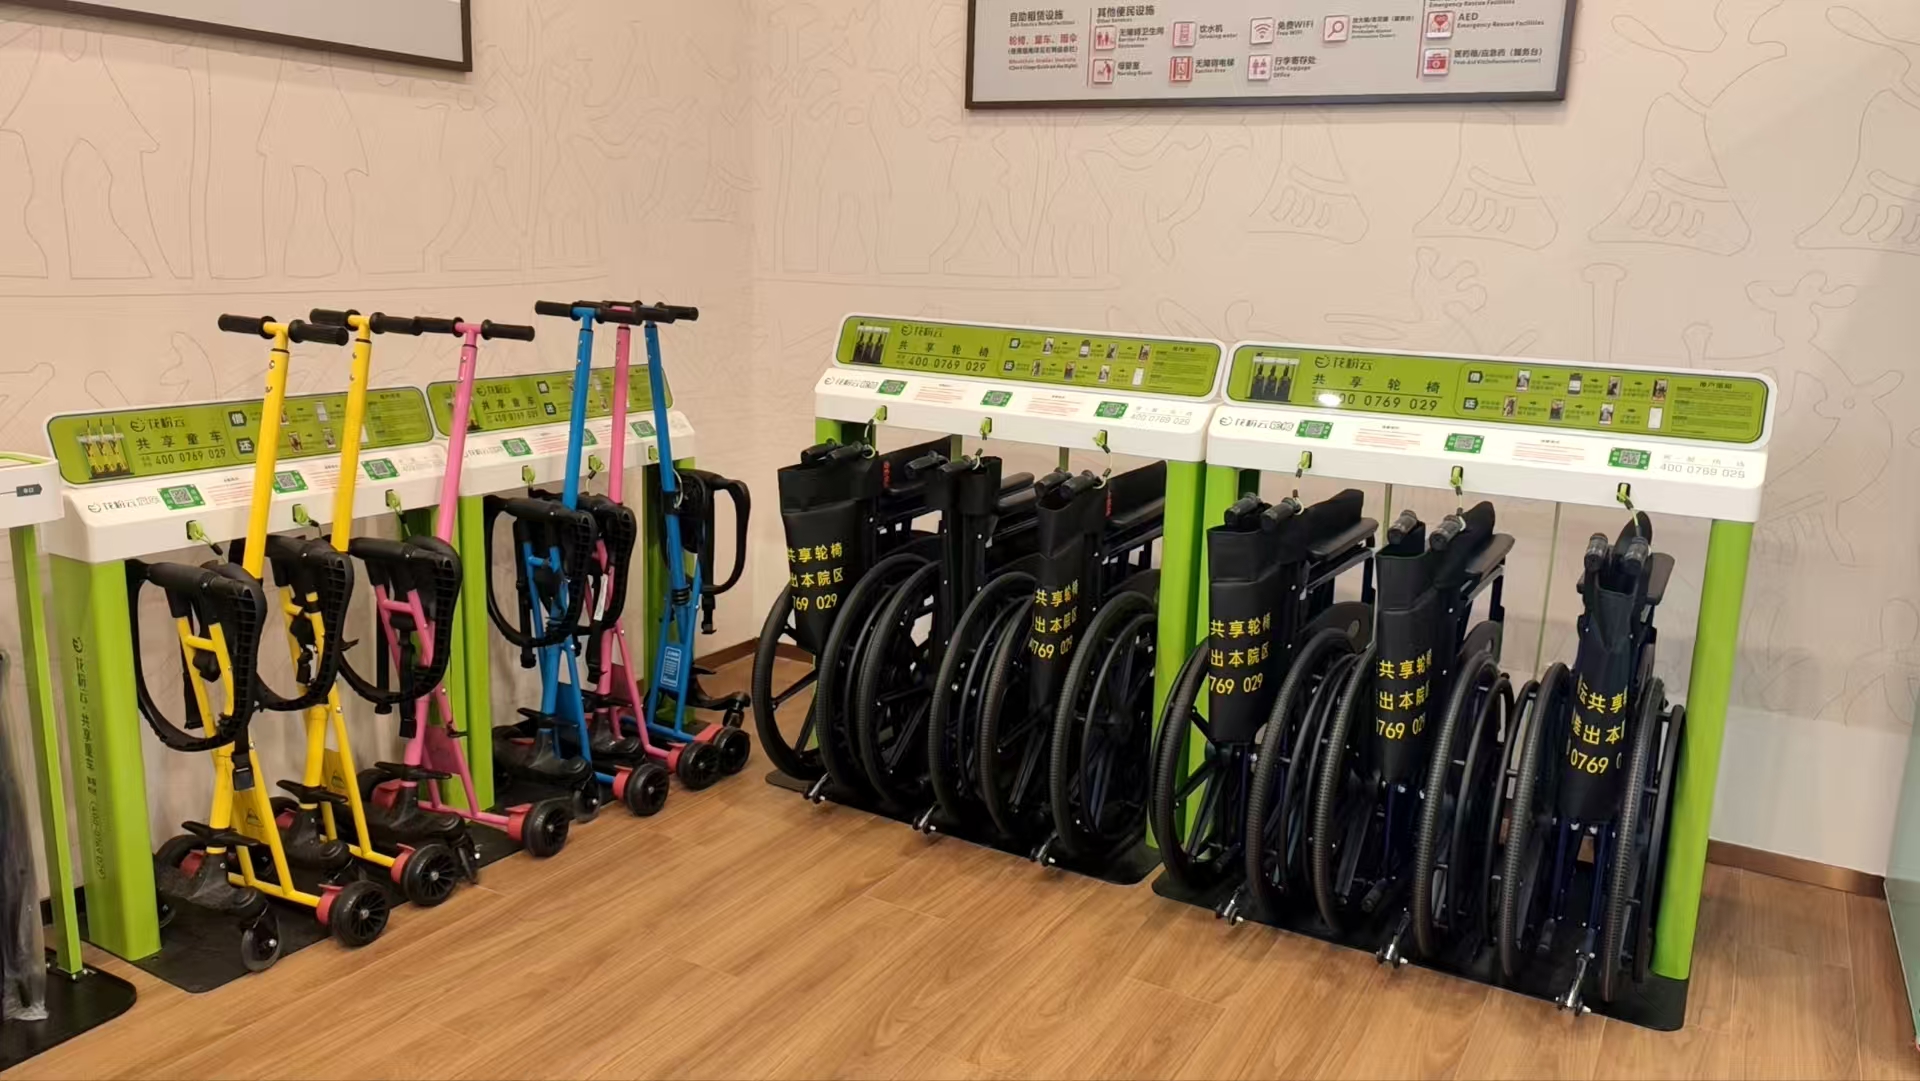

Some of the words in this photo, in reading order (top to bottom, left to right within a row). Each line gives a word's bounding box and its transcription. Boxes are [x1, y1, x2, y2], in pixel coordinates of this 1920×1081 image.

[1458, 13, 1479, 21] AED
[898, 340, 989, 358] 共享轮椅
[908, 356, 929, 368] 400
[933, 358, 960, 370] 0769
[965, 360, 987, 372] 029
[1333, 356, 1373, 371] 花粉云
[1313, 374, 1441, 394] 共享轮椅
[1363, 394, 1401, 409] 0769
[1409, 398, 1438, 412] 029
[136, 430, 224, 452] 共享童车
[155, 453, 176, 466] 400
[180, 450, 205, 463] 0769
[208, 447, 227, 460] 029
[1660, 462, 1683, 473] 400
[1686, 465, 1718, 476] 0769
[1722, 468, 1745, 479] 029
[788, 542, 843, 563] 共享轮椅
[815, 592, 838, 610] 029
[1210, 611, 1271, 638] 共享轮椅
[1210, 641, 1269, 668] 出本院区
[1243, 672, 1264, 693] 029
[1379, 680, 1430, 711] 出本院
[1577, 674, 1628, 714] 云共享
[1376, 716, 1405, 740] 769
[1570, 748, 1609, 774] 0769
